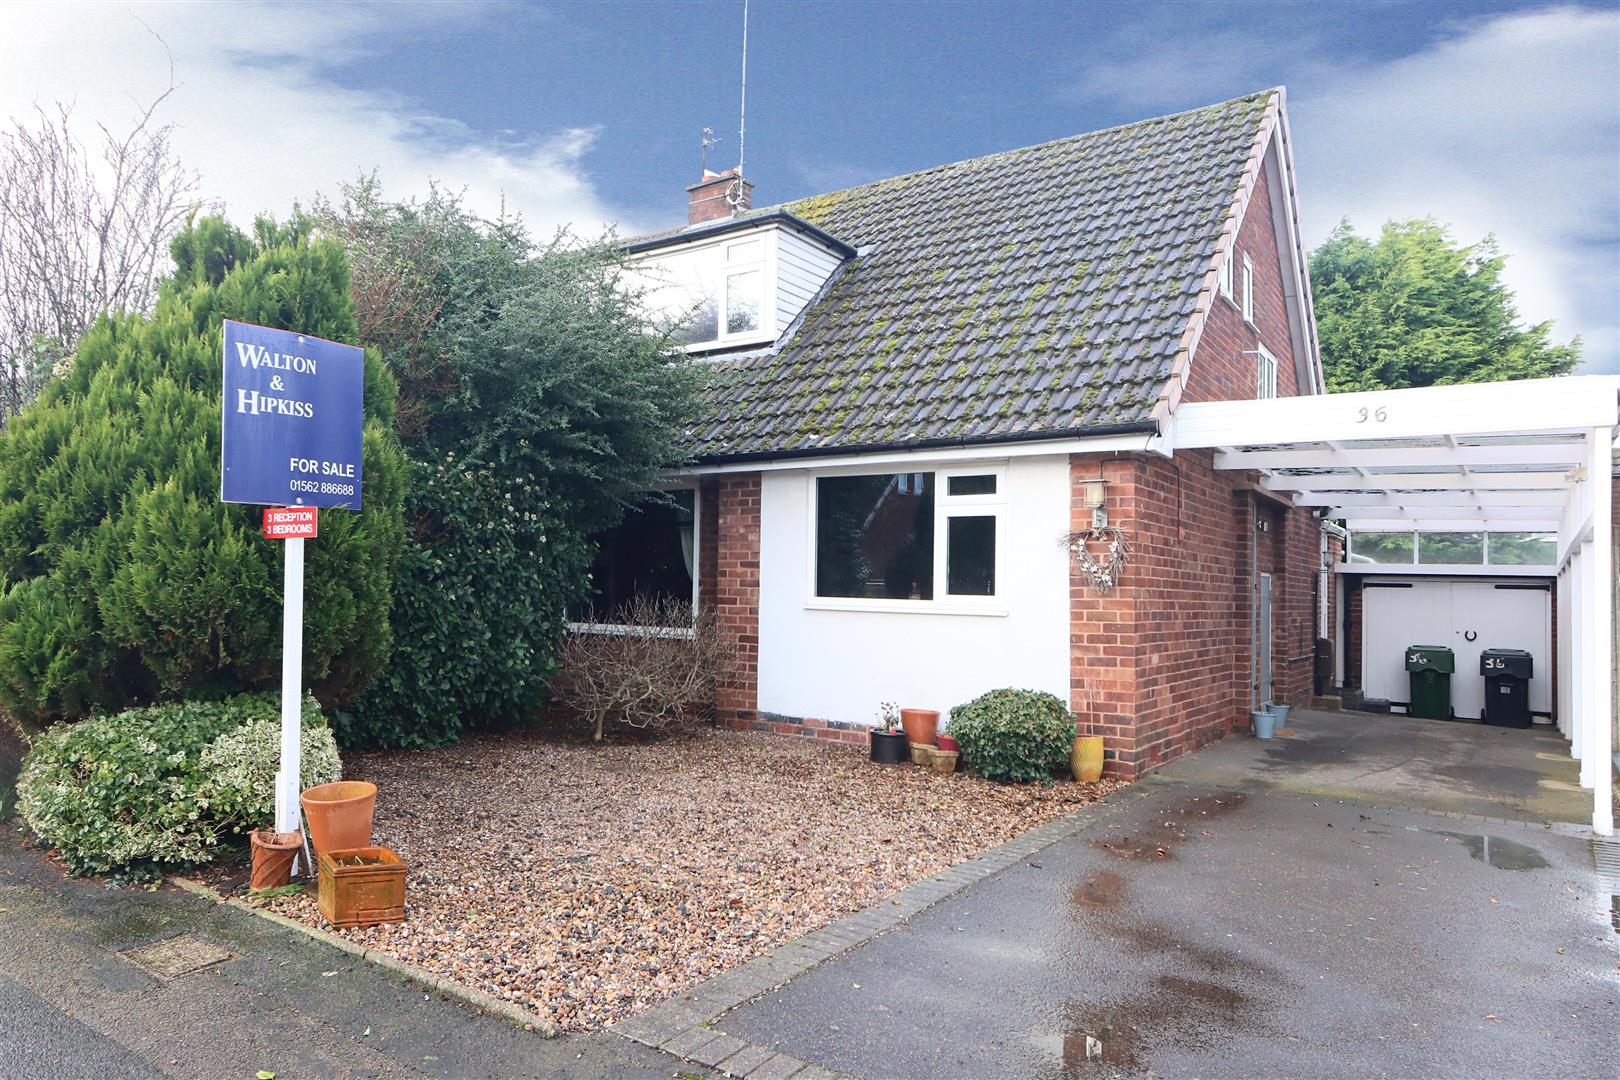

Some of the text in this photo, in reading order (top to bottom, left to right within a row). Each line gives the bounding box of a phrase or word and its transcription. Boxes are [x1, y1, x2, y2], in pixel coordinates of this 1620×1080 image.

[235, 342, 317, 375] WALTON
[270, 375, 285, 391] &
[237, 388, 314, 418] HIPKISS
[1355, 406, 1387, 423] 36
[290, 457, 355, 478] FOR SALE
[290, 479, 354, 496] 01562 886688
[267, 512, 313, 523] 3 RECEPTION
[267, 524, 313, 535] 3 BEDROOMS
